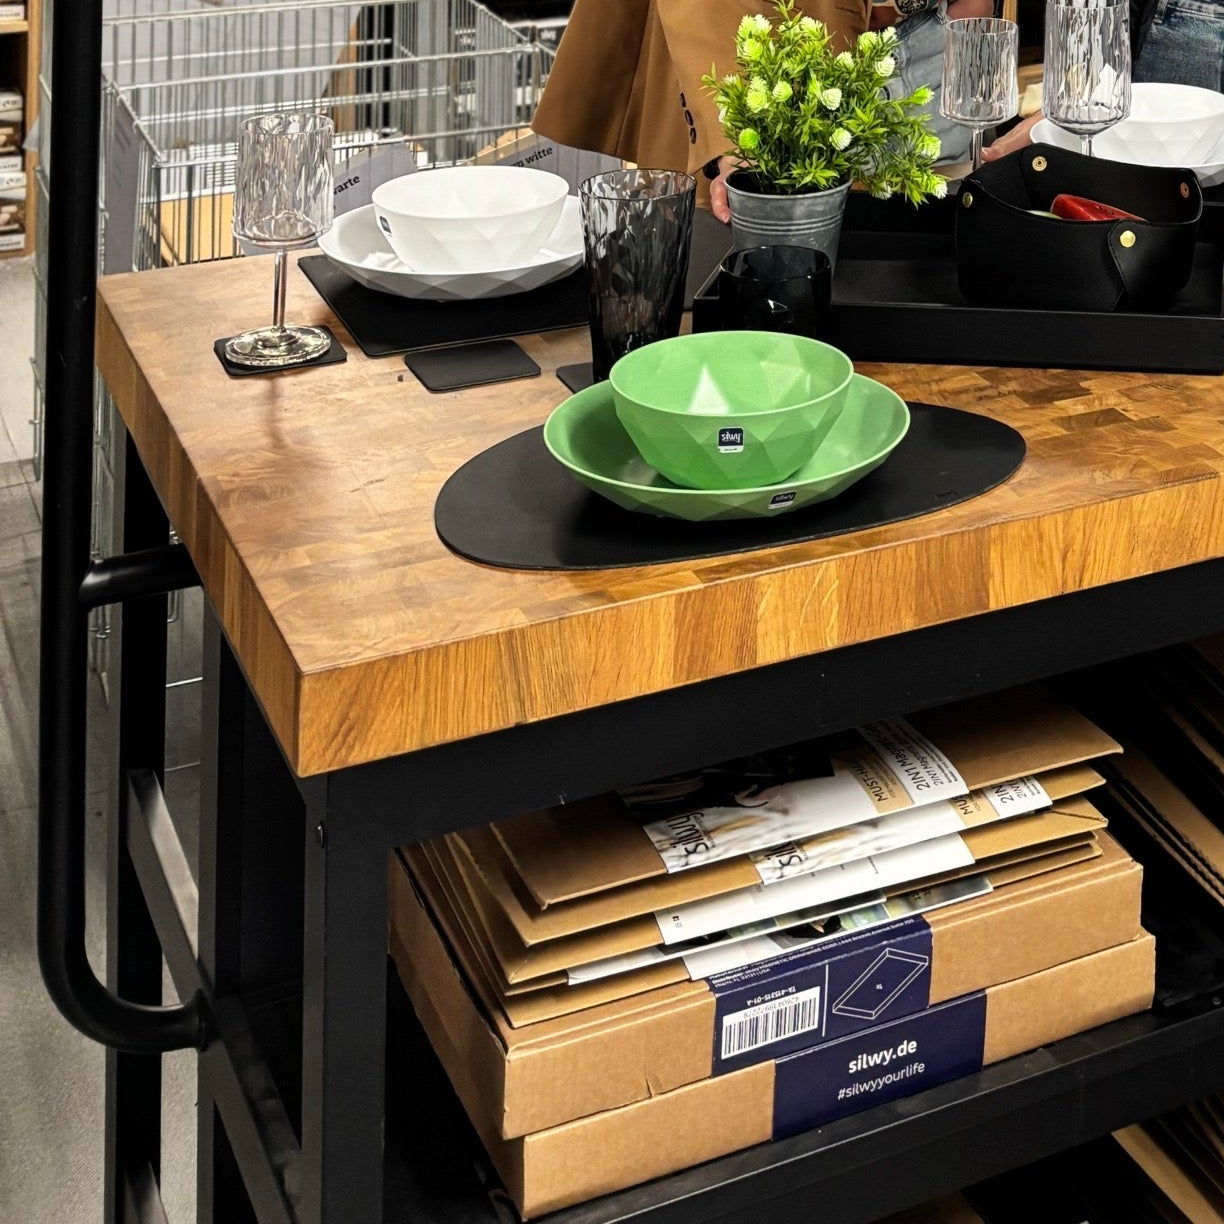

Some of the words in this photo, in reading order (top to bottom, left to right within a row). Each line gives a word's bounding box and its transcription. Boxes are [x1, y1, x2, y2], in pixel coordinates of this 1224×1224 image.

[526, 147, 553, 164] witte
[721, 432, 741, 443] silwy
[667, 812, 708, 856] silwy
[848, 1040, 917, 1074] silwy.de
[837, 1063, 925, 1101] #silwyyourlife
